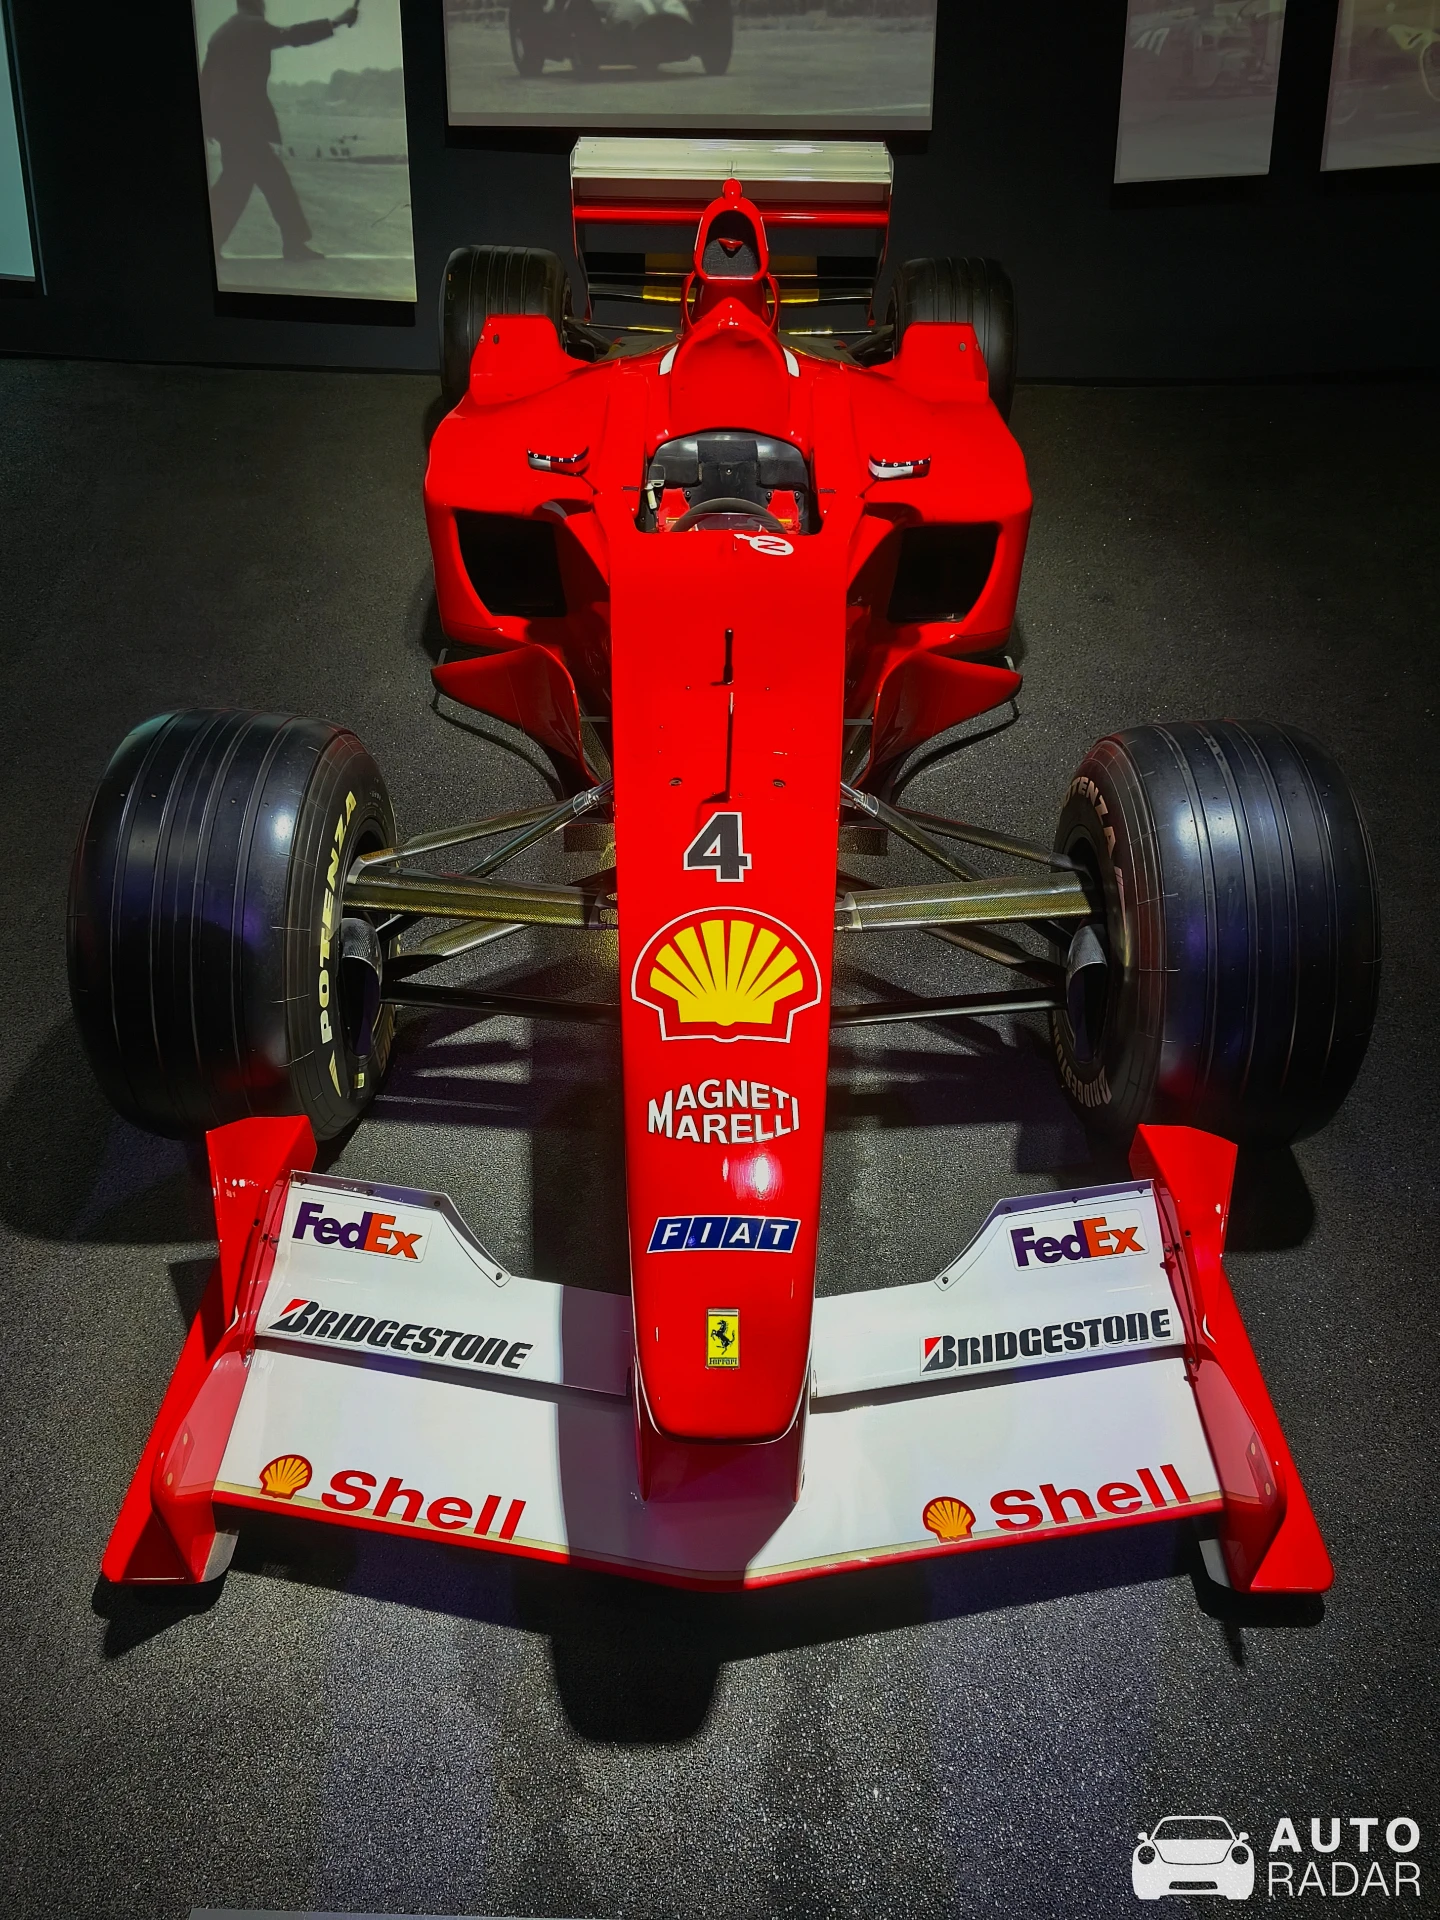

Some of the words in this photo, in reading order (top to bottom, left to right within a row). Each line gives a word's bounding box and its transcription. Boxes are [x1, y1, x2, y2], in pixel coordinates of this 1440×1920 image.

[683, 811, 753, 883] 4
[1062, 776, 1117, 860] OTENZA
[317, 790, 357, 1045] POTENZA
[647, 1078, 800, 1127] MAGNETI
[647, 1101, 800, 1144] MARELLI
[291, 1201, 423, 1260] FedEx
[661, 1221, 790, 1245] FIAT
[1009, 1217, 1146, 1267] FedEx
[267, 1298, 534, 1370] BRIDGESTONE
[922, 1308, 1171, 1373] BRIDGESTONE
[320, 1469, 527, 1541] Shell
[989, 1463, 1191, 1532] Shell
